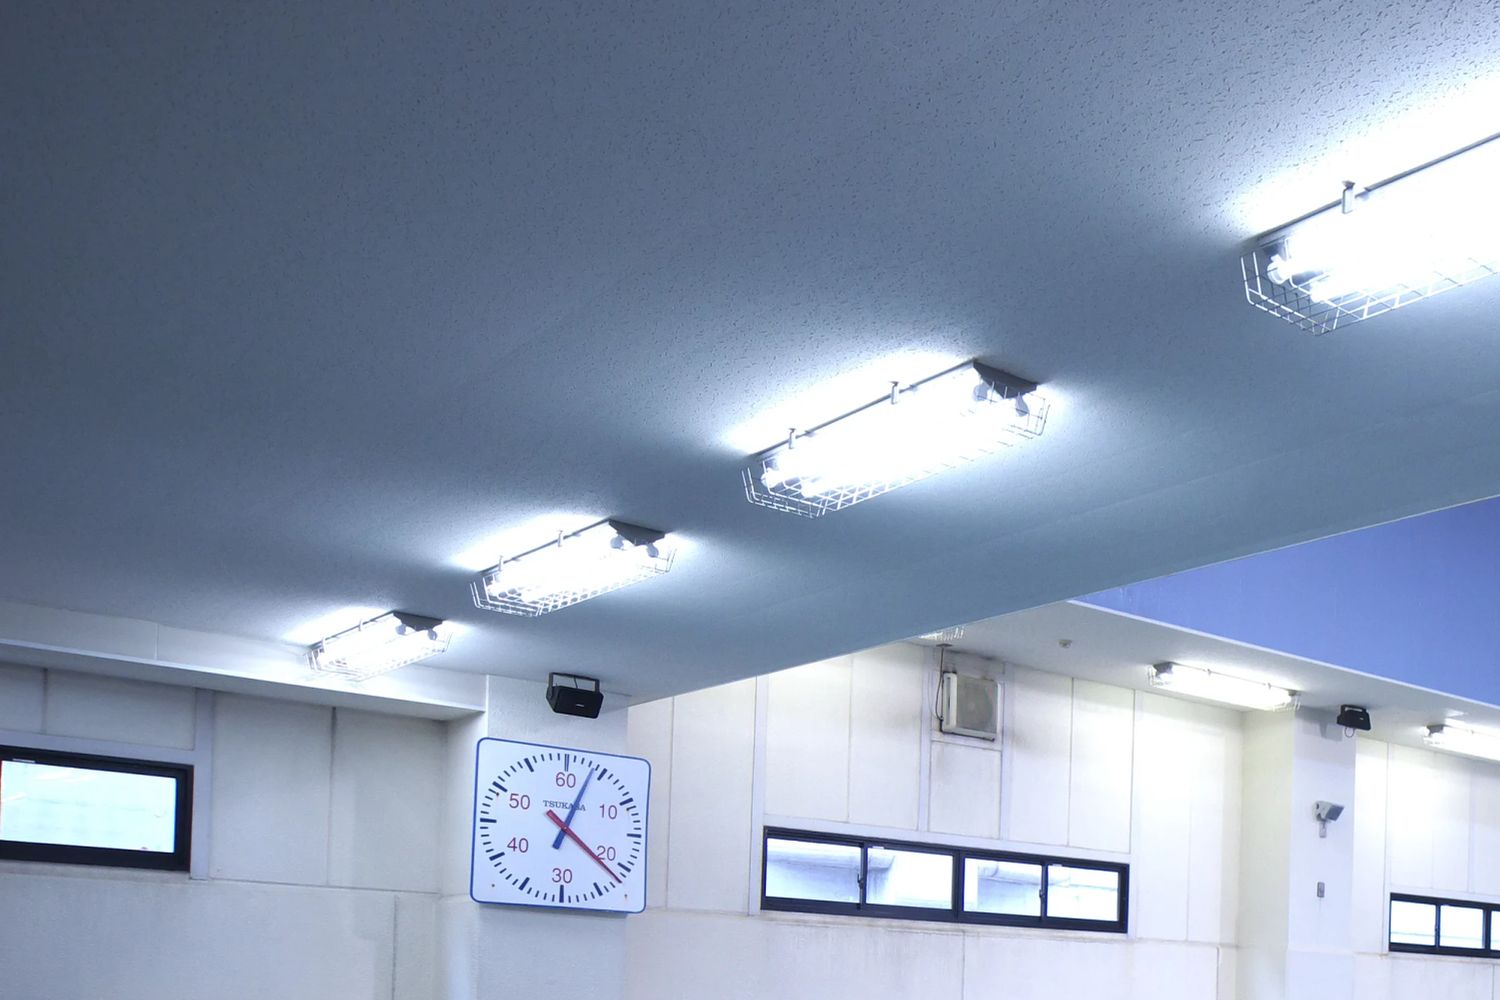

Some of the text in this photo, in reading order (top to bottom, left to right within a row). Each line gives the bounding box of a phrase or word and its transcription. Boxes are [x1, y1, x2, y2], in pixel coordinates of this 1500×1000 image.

[555, 771, 576, 788] 60
[509, 793, 530, 810] 50
[542, 799, 586, 811] TSUKASA
[599, 803, 618, 819] 10
[507, 837, 529, 853] 40
[596, 845, 616, 861] 20
[552, 867, 573, 884] 30
